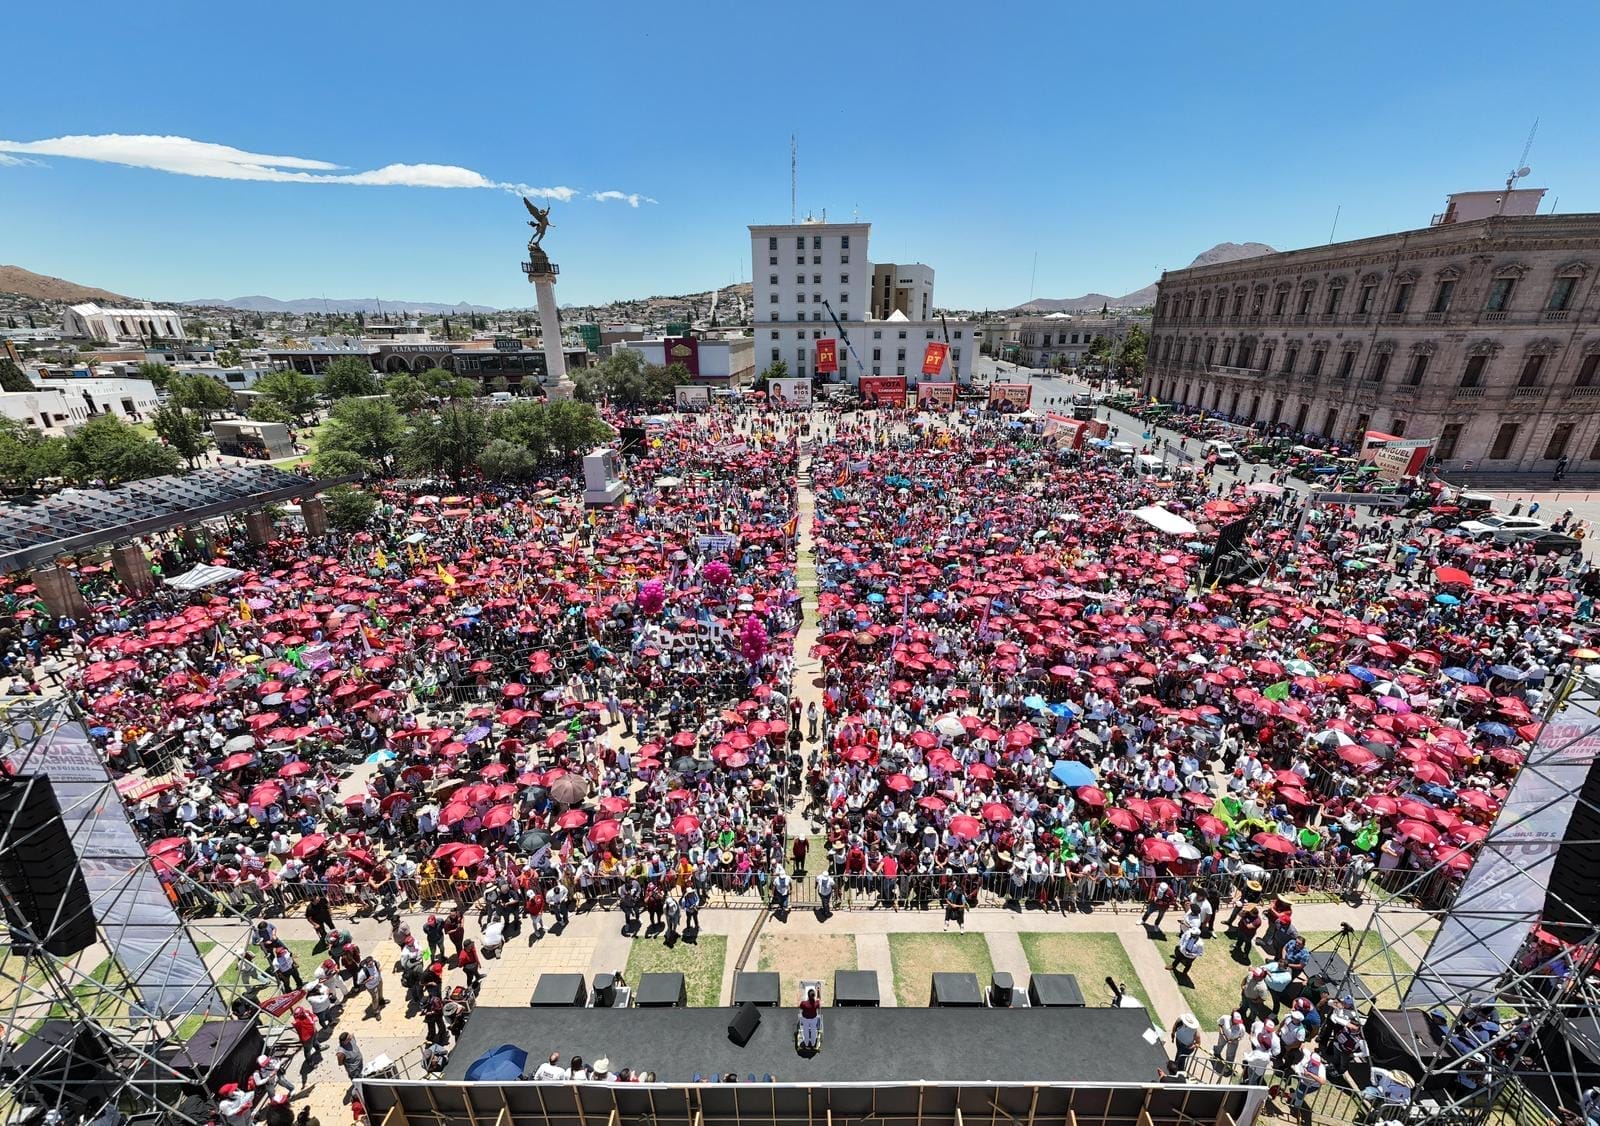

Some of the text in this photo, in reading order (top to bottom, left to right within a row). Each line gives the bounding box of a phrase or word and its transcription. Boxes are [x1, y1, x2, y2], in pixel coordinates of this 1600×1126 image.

[391, 345, 412, 353] PLAZA
[820, 352, 833, 362] PT
[926, 354, 941, 365] PT
